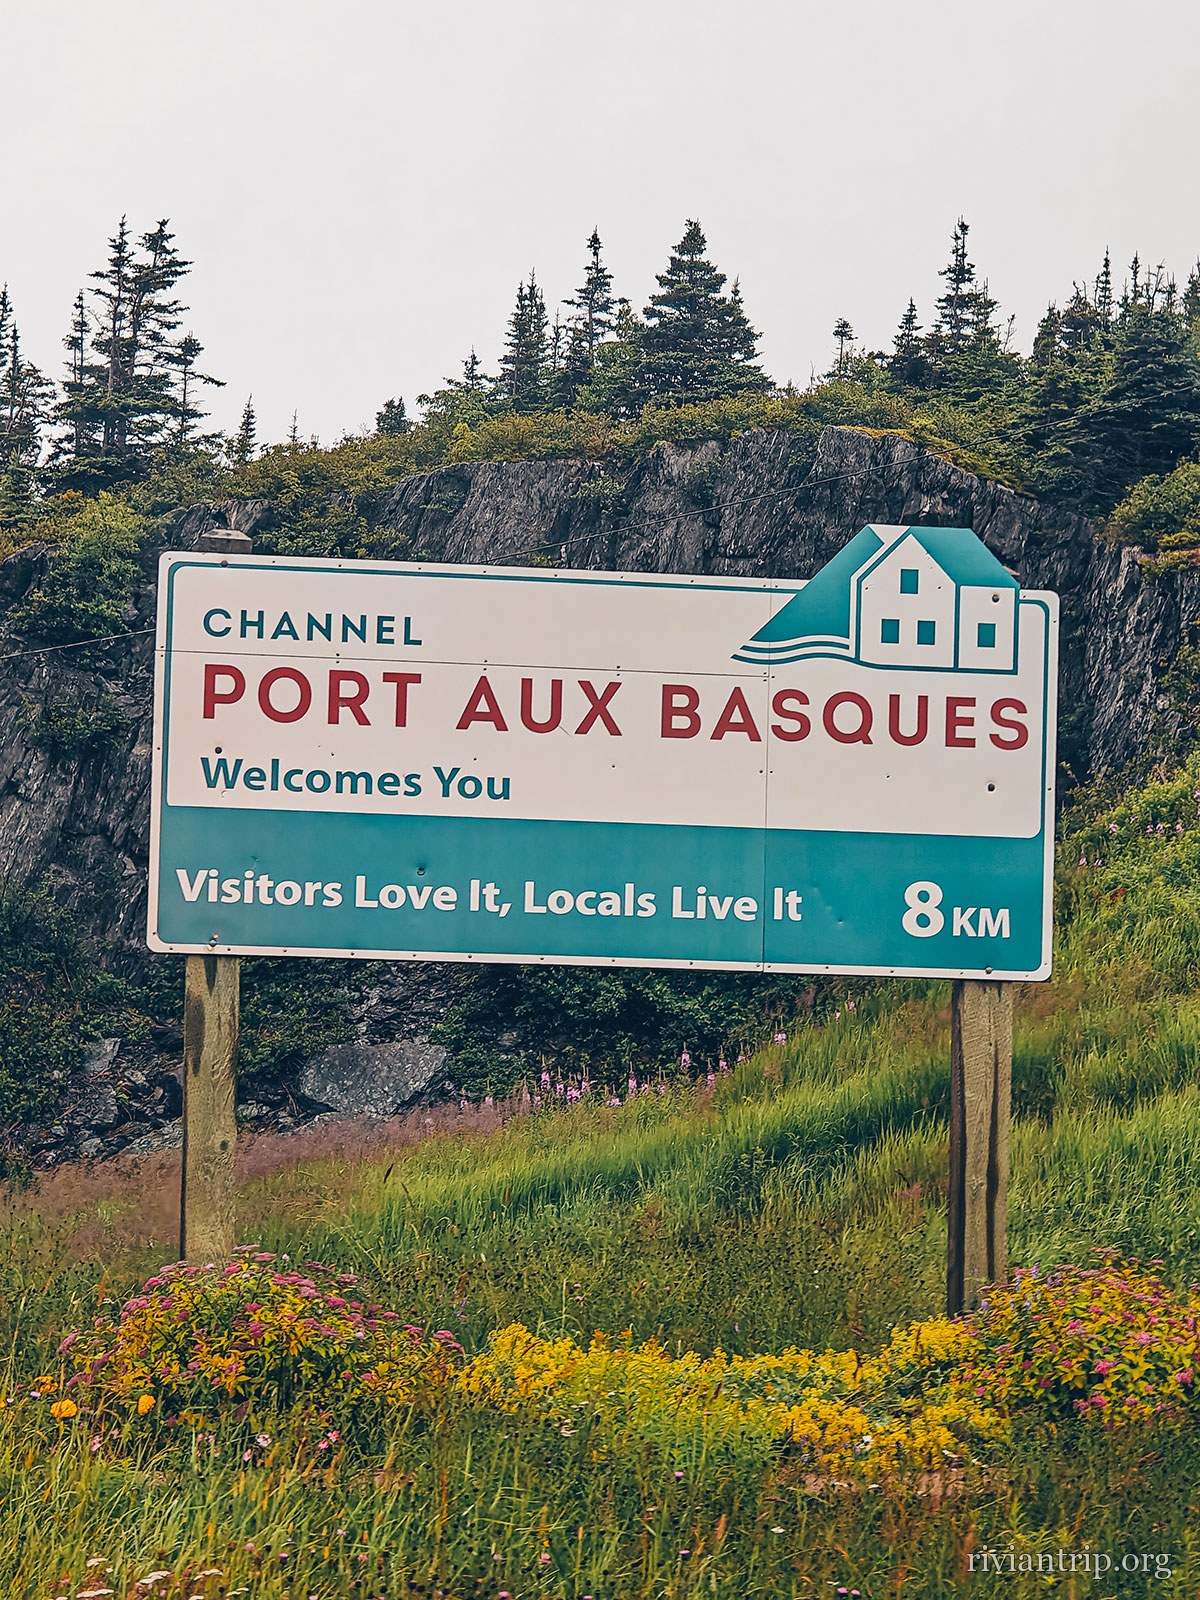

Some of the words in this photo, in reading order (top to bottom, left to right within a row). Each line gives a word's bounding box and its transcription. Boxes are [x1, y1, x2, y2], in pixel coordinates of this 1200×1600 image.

[203, 608, 422, 646] CHANNEL
[203, 664, 422, 728] PORT
[455, 675, 623, 737] AUX
[660, 683, 1029, 750] BASQUES
[200, 757, 422, 797] Welcomes
[433, 766, 511, 801] You
[176, 869, 342, 907] Visitors
[355, 875, 457, 911] Love
[470, 879, 511, 917] It,
[524, 881, 657, 919] Locals
[672, 886, 758, 921] Live
[773, 887, 802, 921] It
[902, 881, 945, 938] 8
[952, 907, 1010, 938] KM
